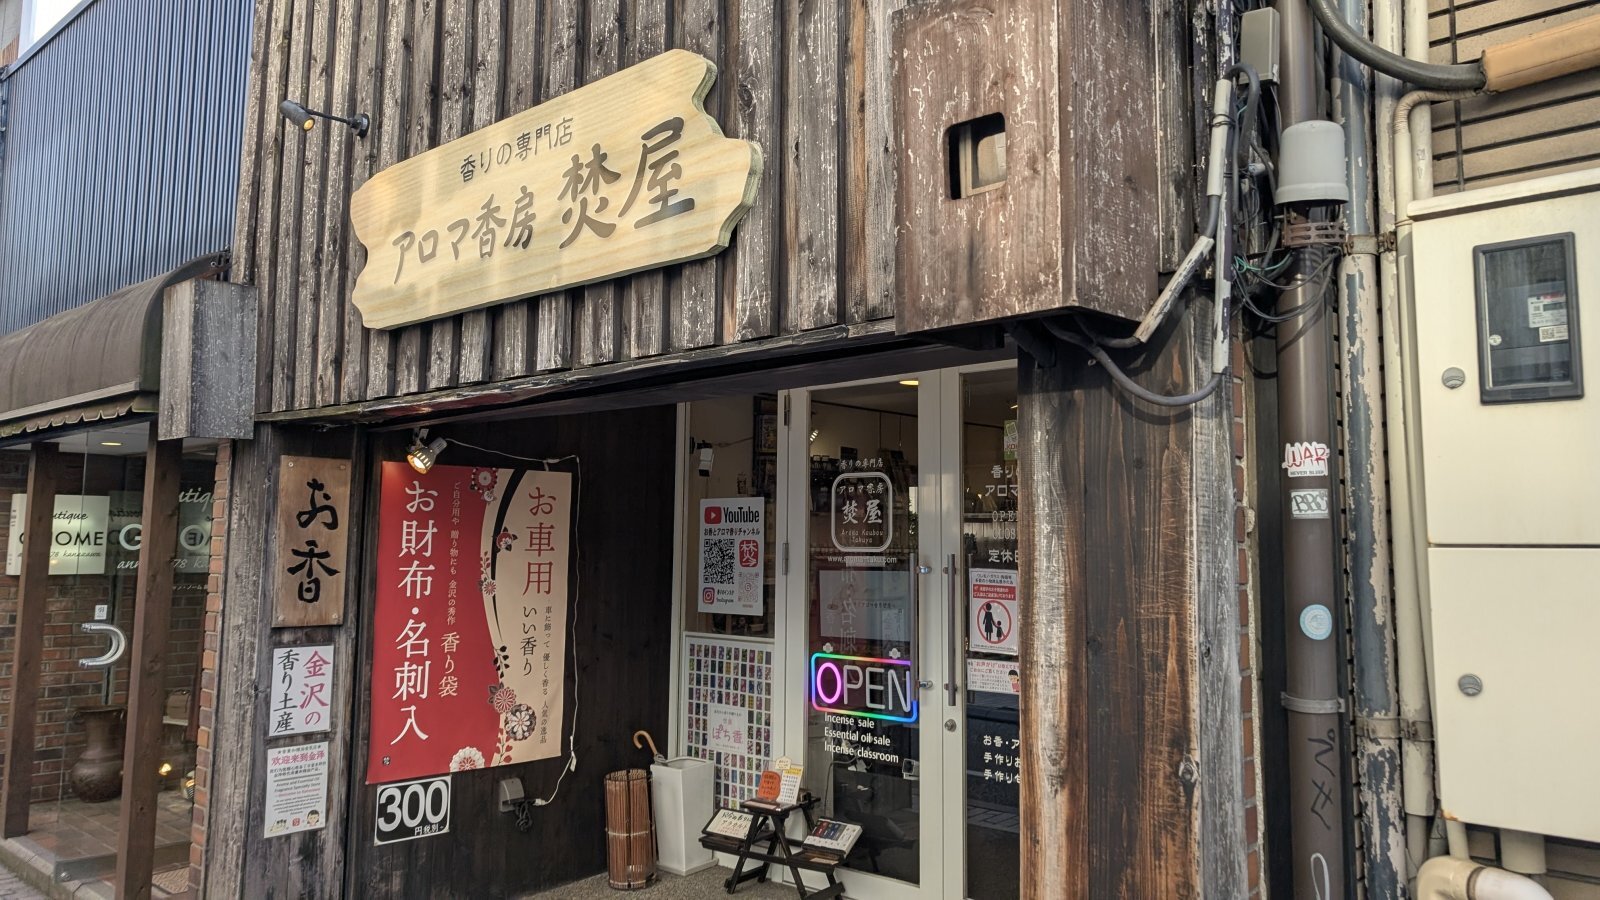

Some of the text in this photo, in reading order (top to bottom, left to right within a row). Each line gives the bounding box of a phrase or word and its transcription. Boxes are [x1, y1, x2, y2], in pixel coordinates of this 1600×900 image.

[460, 116, 574, 182] 香りの専門店
[392, 116, 695, 285] アロマ香房 焚屋
[840, 458, 883, 470] 香りの専門店
[704, 527, 760, 536] お香とアロマ香りチャンネル
[723, 506, 760, 523] YouTube
[841, 499, 883, 524] 焚屋
[992, 511, 1019, 522] OPE
[287, 478, 340, 603] お香
[438, 482, 461, 698] ご自分用や 贈り物にも 金沢の秀作 香り袋
[520, 486, 556, 677] お車用 いい香り
[391, 480, 438, 745] お財布・名刺入
[543, 606, 552, 648] 車に飾って
[273, 649, 300, 733] 香り土産
[300, 650, 331, 725] 金沢の
[541, 653, 550, 696] 優しく香る
[817, 662, 911, 713] OPEN
[824, 712, 875, 728] Incense sale
[824, 727, 891, 746] Essential oil sale
[824, 741, 899, 763] Incense classroom
[378, 780, 448, 832] 300
